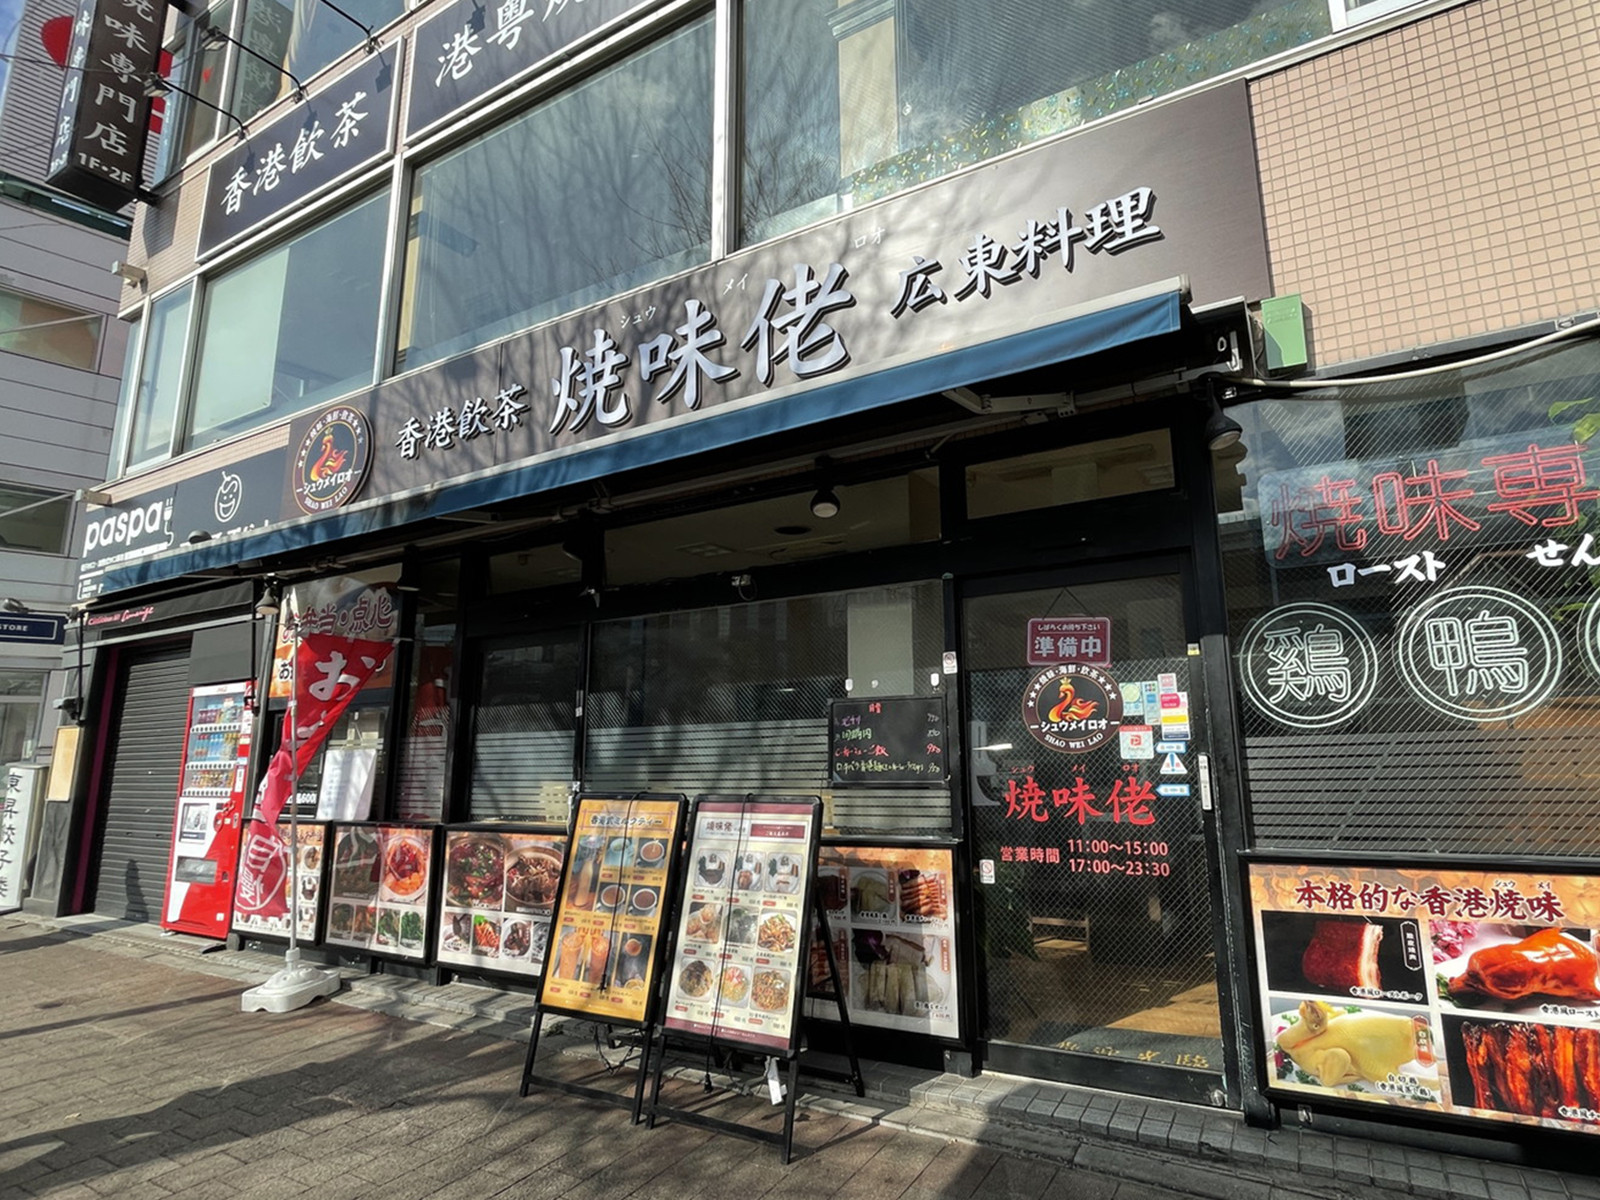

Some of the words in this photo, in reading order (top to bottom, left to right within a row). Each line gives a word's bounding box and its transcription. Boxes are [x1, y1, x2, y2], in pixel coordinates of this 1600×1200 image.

[434, 0, 588, 88] 港粤
[220, 92, 368, 217] 香港飲茶
[619, 305, 656, 328] シュウ
[722, 273, 748, 295] メイ
[396, 383, 526, 460] 香港飲茶
[549, 262, 856, 434] 焼味佬
[890, 186, 1163, 316] 広東料理
[82, 501, 164, 558] paspa
[1327, 550, 1447, 588] ロースト
[0, 623, 28, 632] TORE
[1033, 635, 1102, 658] 準備中
[1425, 610, 1529, 697] 鴨
[1040, 718, 1108, 733] シュウメイロオ
[1044, 734, 1066, 748] SHAO
[1069, 740, 1086, 749] WEI
[1011, 765, 1035, 774] シュウ
[1072, 764, 1087, 773] メイ
[1122, 763, 1140, 773] ロオ
[1004, 776, 1157, 826] 焼味佬
[1000, 846, 1061, 864] 営業時間
[1295, 880, 1565, 923] 本格的な香港焼味
[1494, 879, 1517, 888] シュウ
[1537, 881, 1552, 889] メイ
